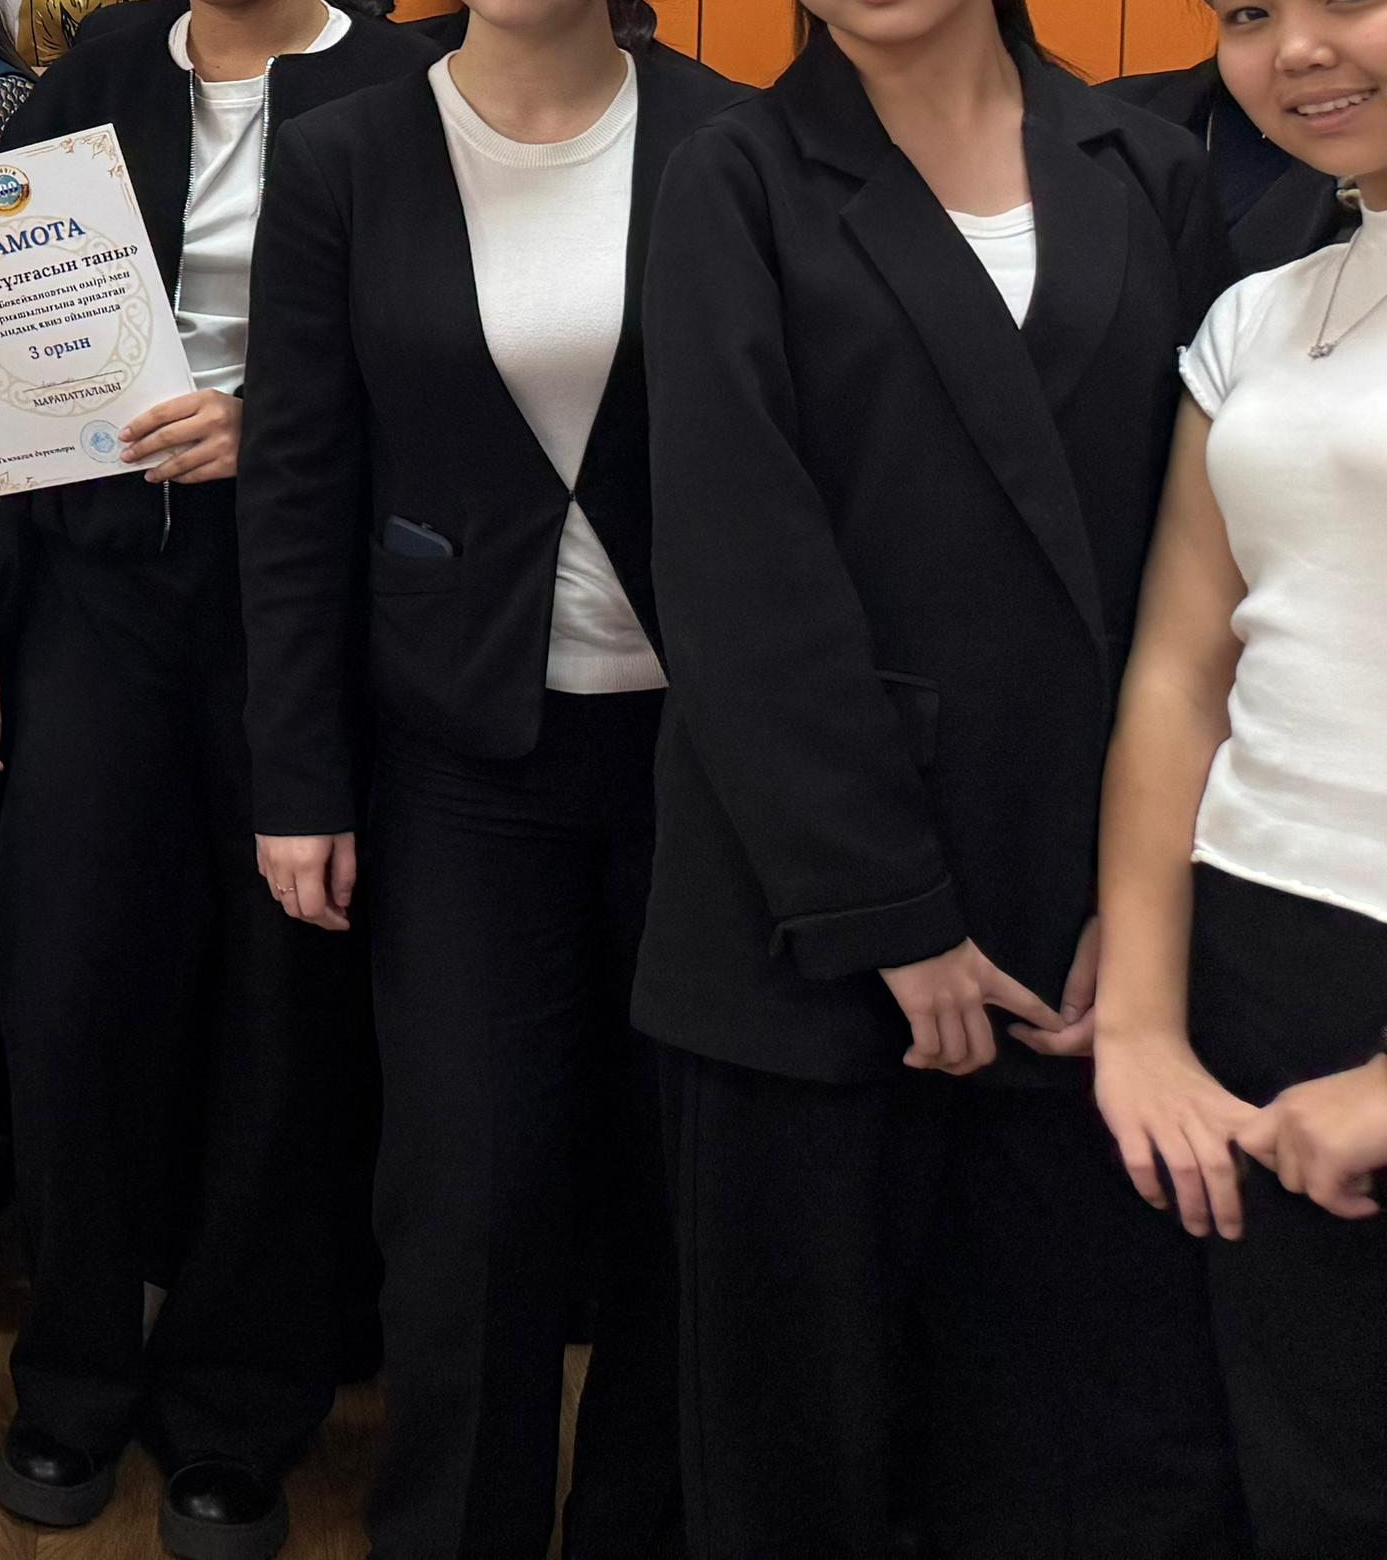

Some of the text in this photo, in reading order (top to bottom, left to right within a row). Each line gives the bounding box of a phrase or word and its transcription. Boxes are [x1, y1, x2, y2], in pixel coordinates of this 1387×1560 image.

[81, 244, 138, 268] таны»
[28, 337, 91, 360] 3 орын
